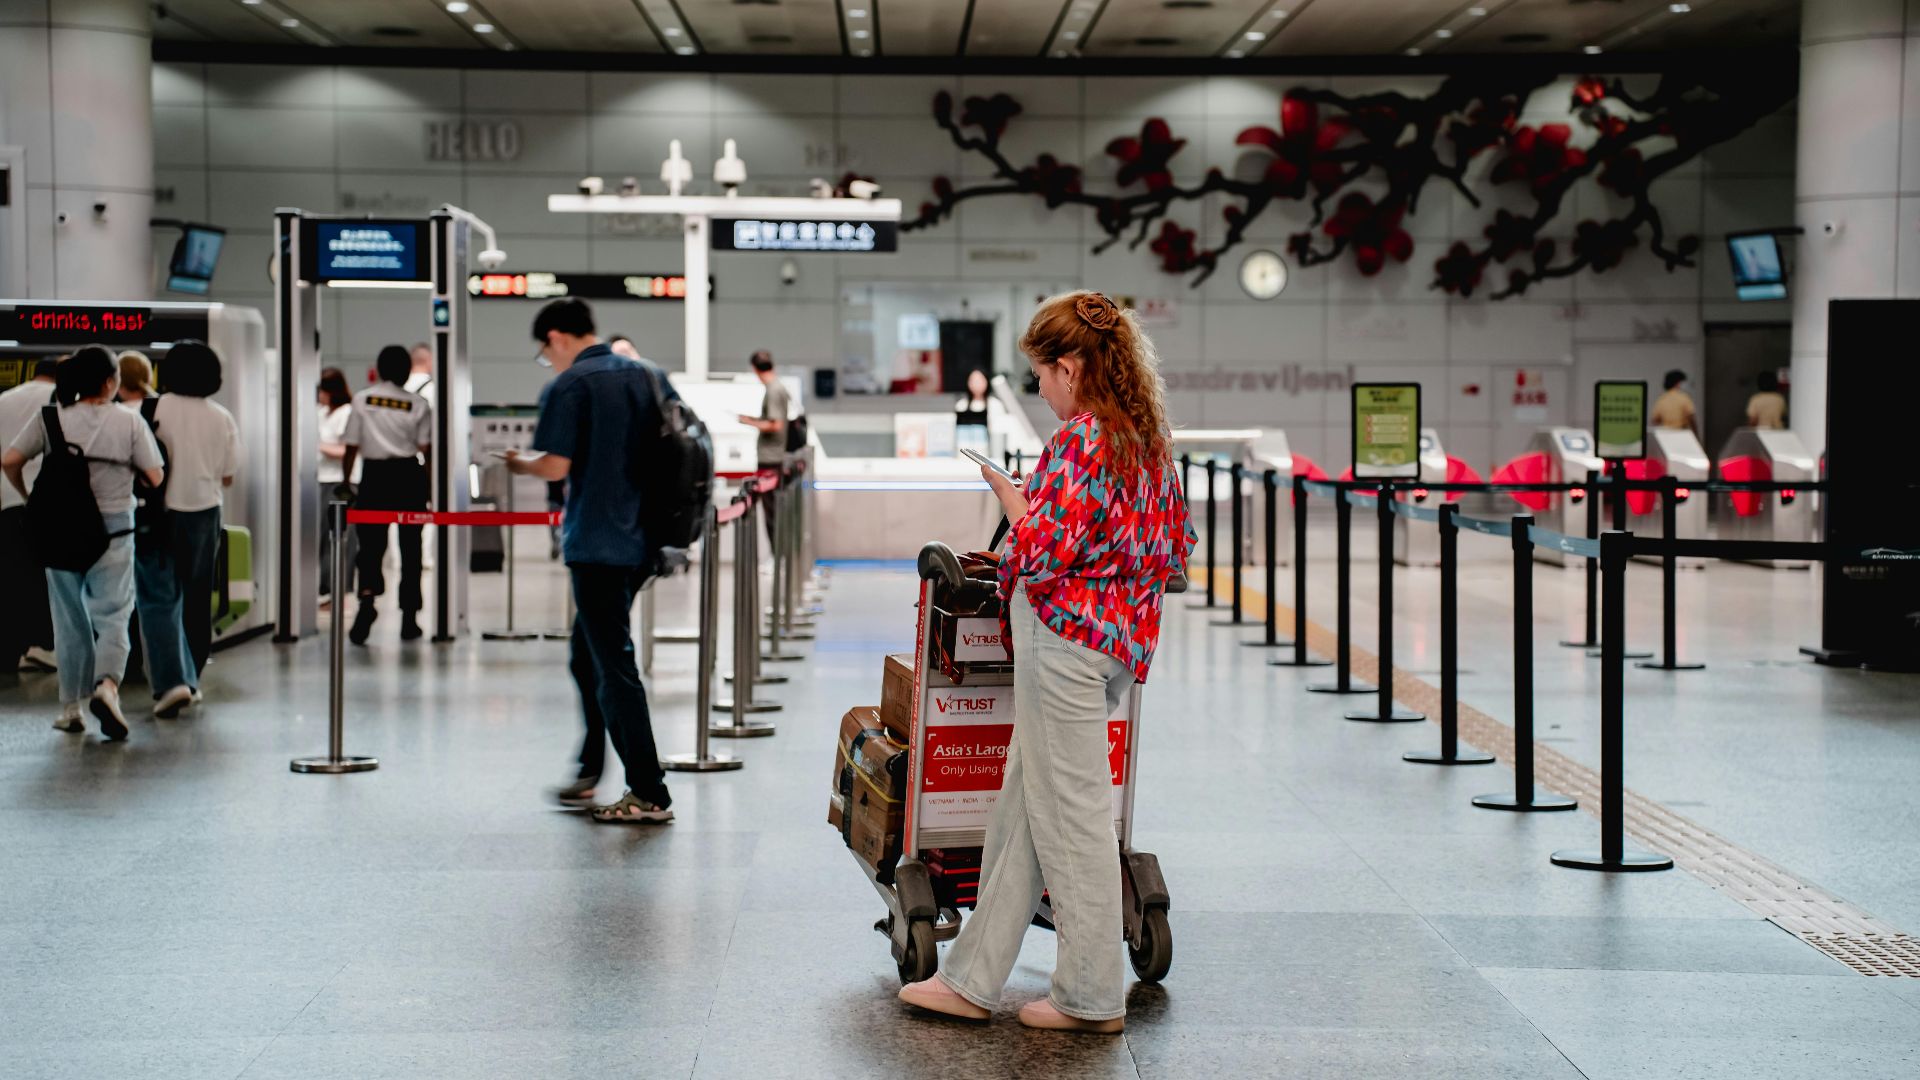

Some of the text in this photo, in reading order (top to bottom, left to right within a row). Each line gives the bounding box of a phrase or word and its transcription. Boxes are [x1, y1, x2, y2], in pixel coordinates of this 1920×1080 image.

[423, 121, 522, 161] HELLO
[32, 312, 97, 333] drinks,
[933, 744, 972, 757] Asia's
[940, 765, 966, 777] Only
[969, 764, 998, 776] Using
